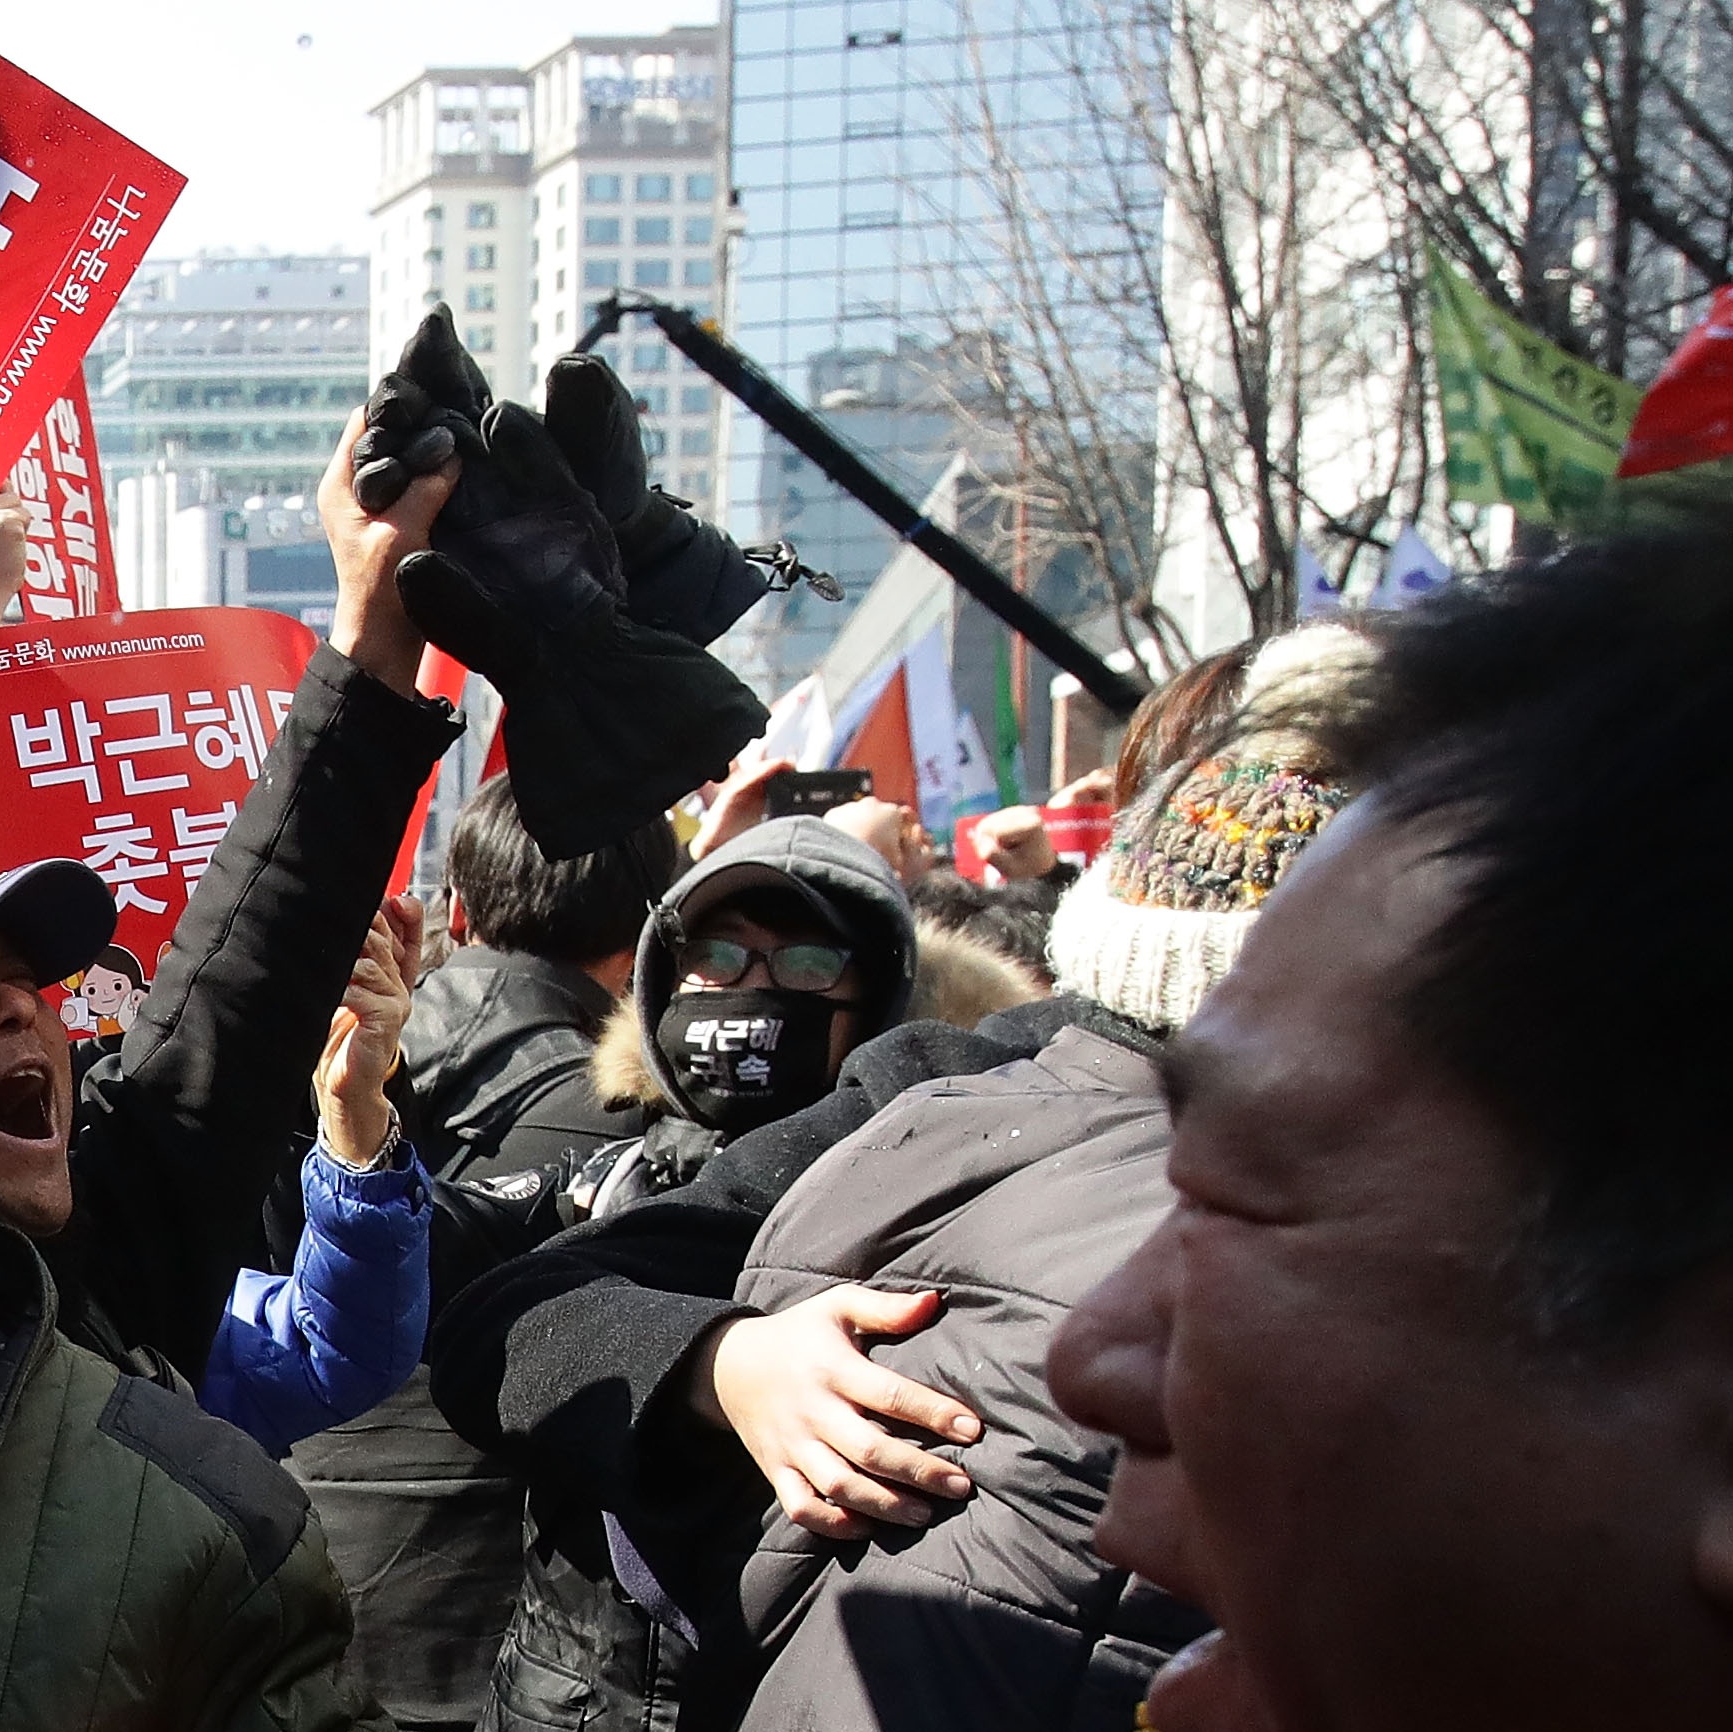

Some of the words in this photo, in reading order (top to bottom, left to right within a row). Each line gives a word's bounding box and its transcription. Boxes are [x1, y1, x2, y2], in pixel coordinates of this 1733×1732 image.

[53, 183, 147, 318] 나눔문화
[61, 631, 205, 662] www.nanum.com
[10, 682, 268, 804] 박근혜
[685, 1019, 784, 1051] 박근혜
